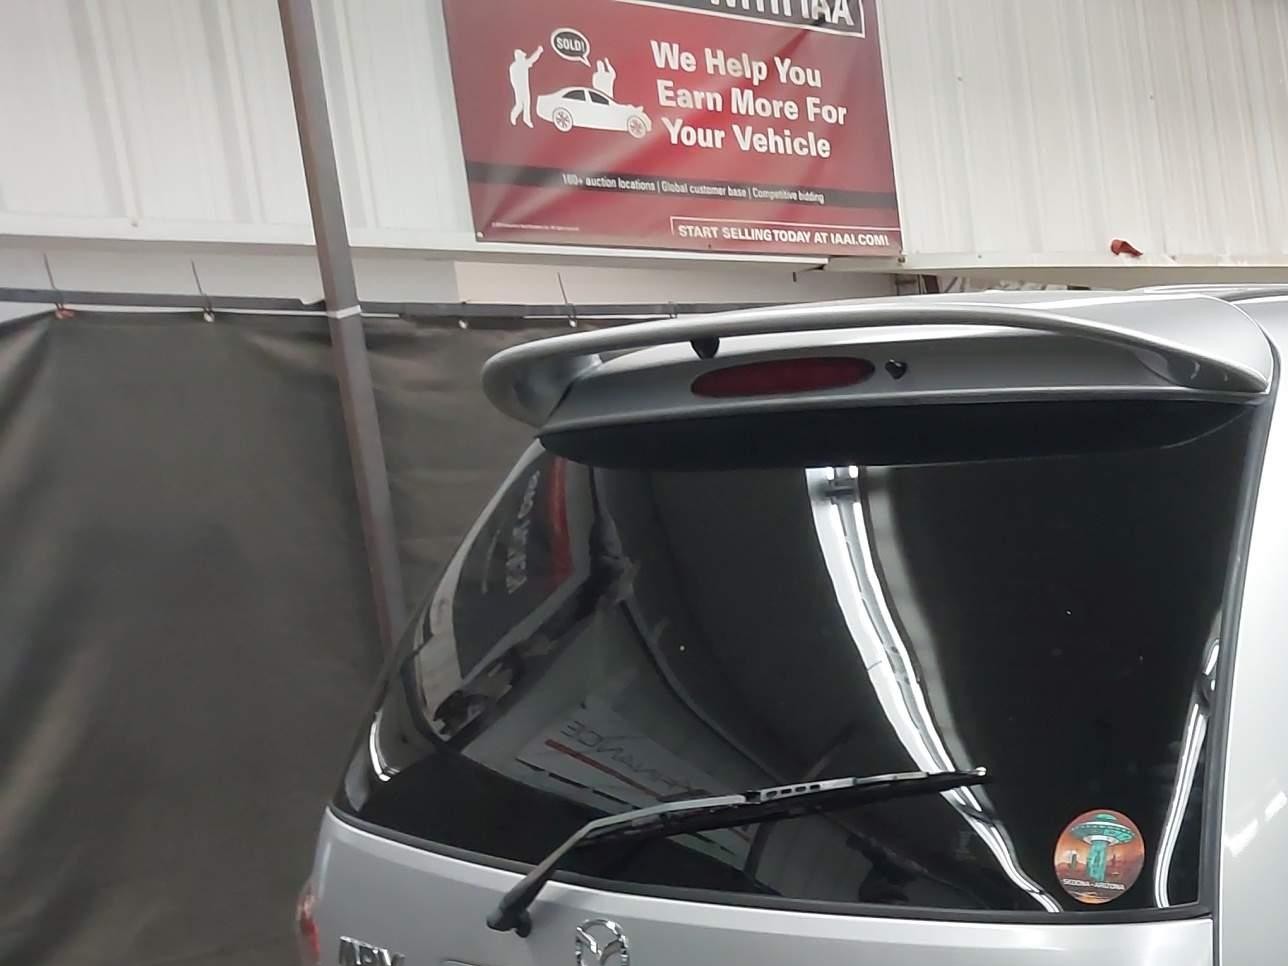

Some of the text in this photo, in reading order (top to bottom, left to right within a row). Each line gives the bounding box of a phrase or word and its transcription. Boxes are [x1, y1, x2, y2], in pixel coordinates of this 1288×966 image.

[556, 36, 585, 52] SOLD!
[650, 40, 822, 88] We Help You
[656, 79, 847, 125] Earn More For
[661, 117, 831, 158] Your Vehicle
[585, 176, 617, 188] auction
[618, 177, 656, 191] locations
[661, 181, 688, 194] Global
[689, 185, 726, 196] customer
[728, 185, 747, 198] base
[752, 187, 797, 201] Competitive
[798, 190, 825, 205] bidding
[678, 225, 719, 239] START
[814, 231, 829, 244] AT
[830, 232, 890, 247] IAAI.COM!
